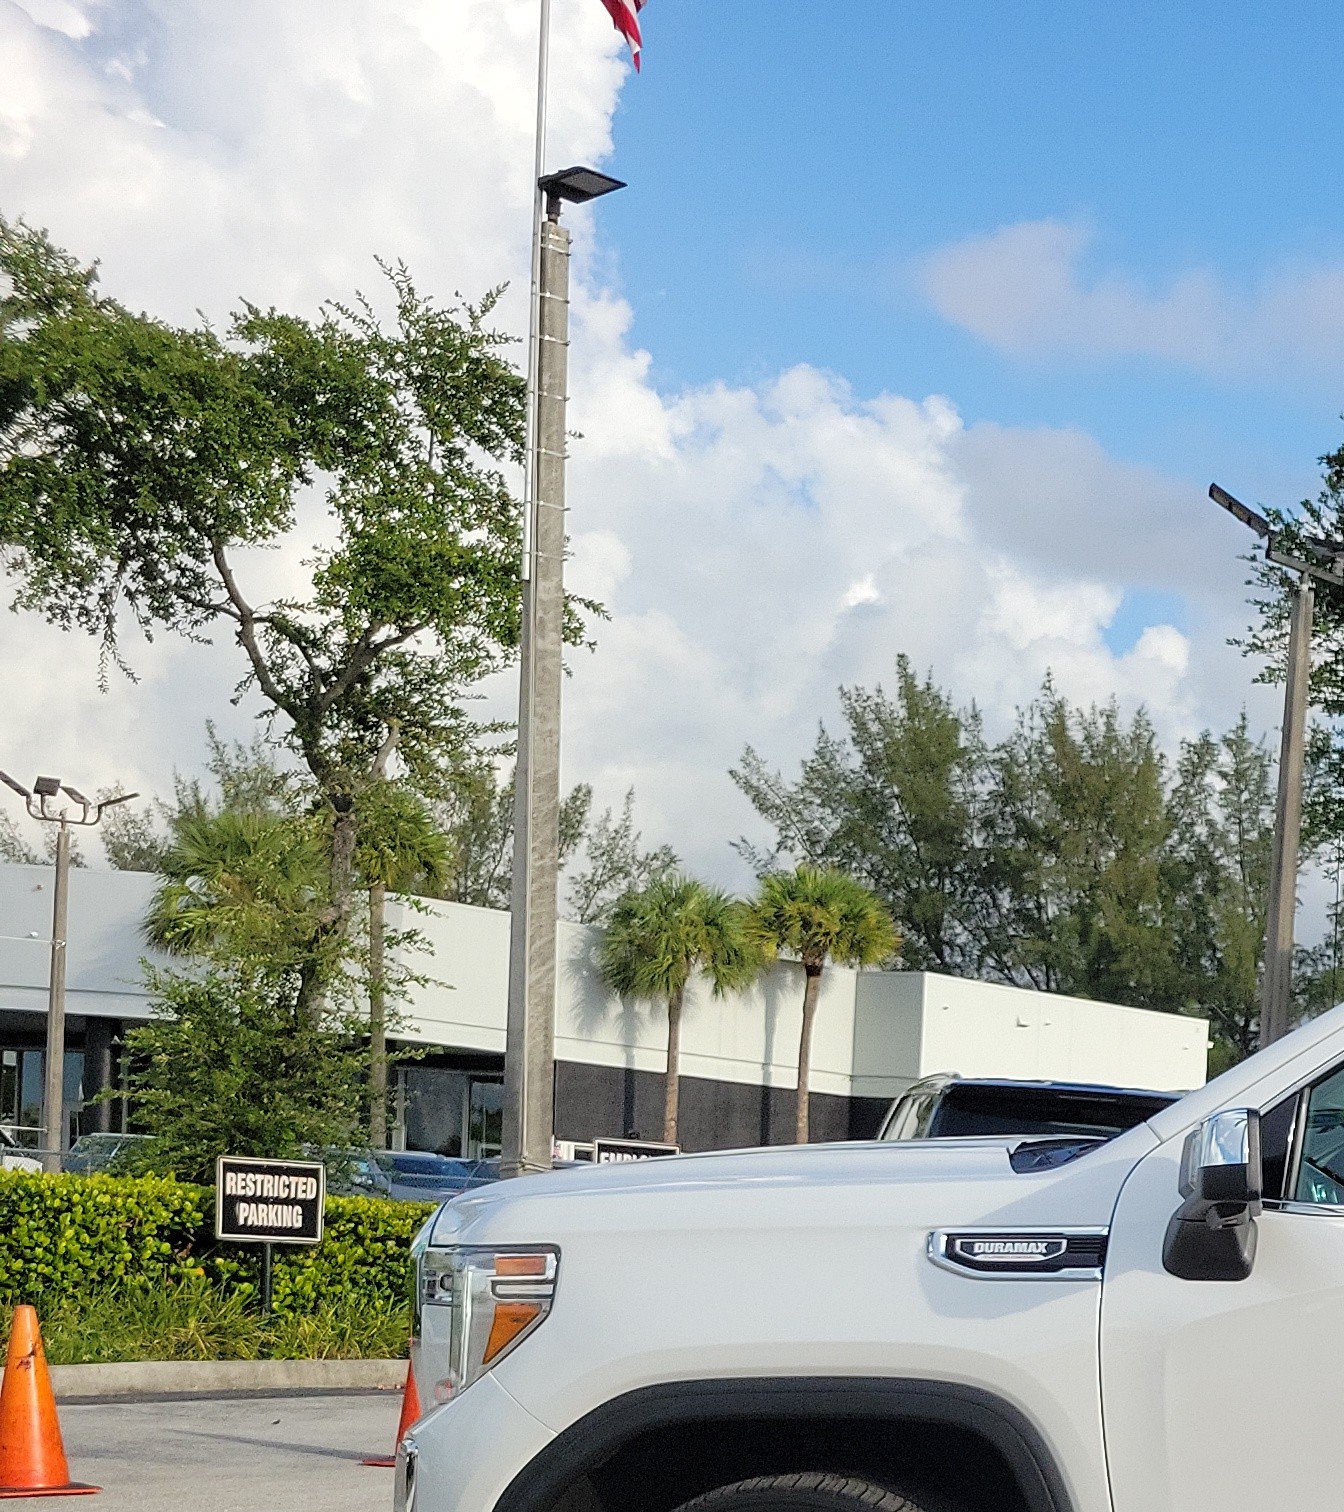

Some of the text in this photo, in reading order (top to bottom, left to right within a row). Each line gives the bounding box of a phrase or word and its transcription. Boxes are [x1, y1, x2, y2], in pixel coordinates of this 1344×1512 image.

[225, 1171, 318, 1200] RESTRICTED
[237, 1202, 303, 1229] PARKING
[973, 1242, 1049, 1253] DURAMAX
